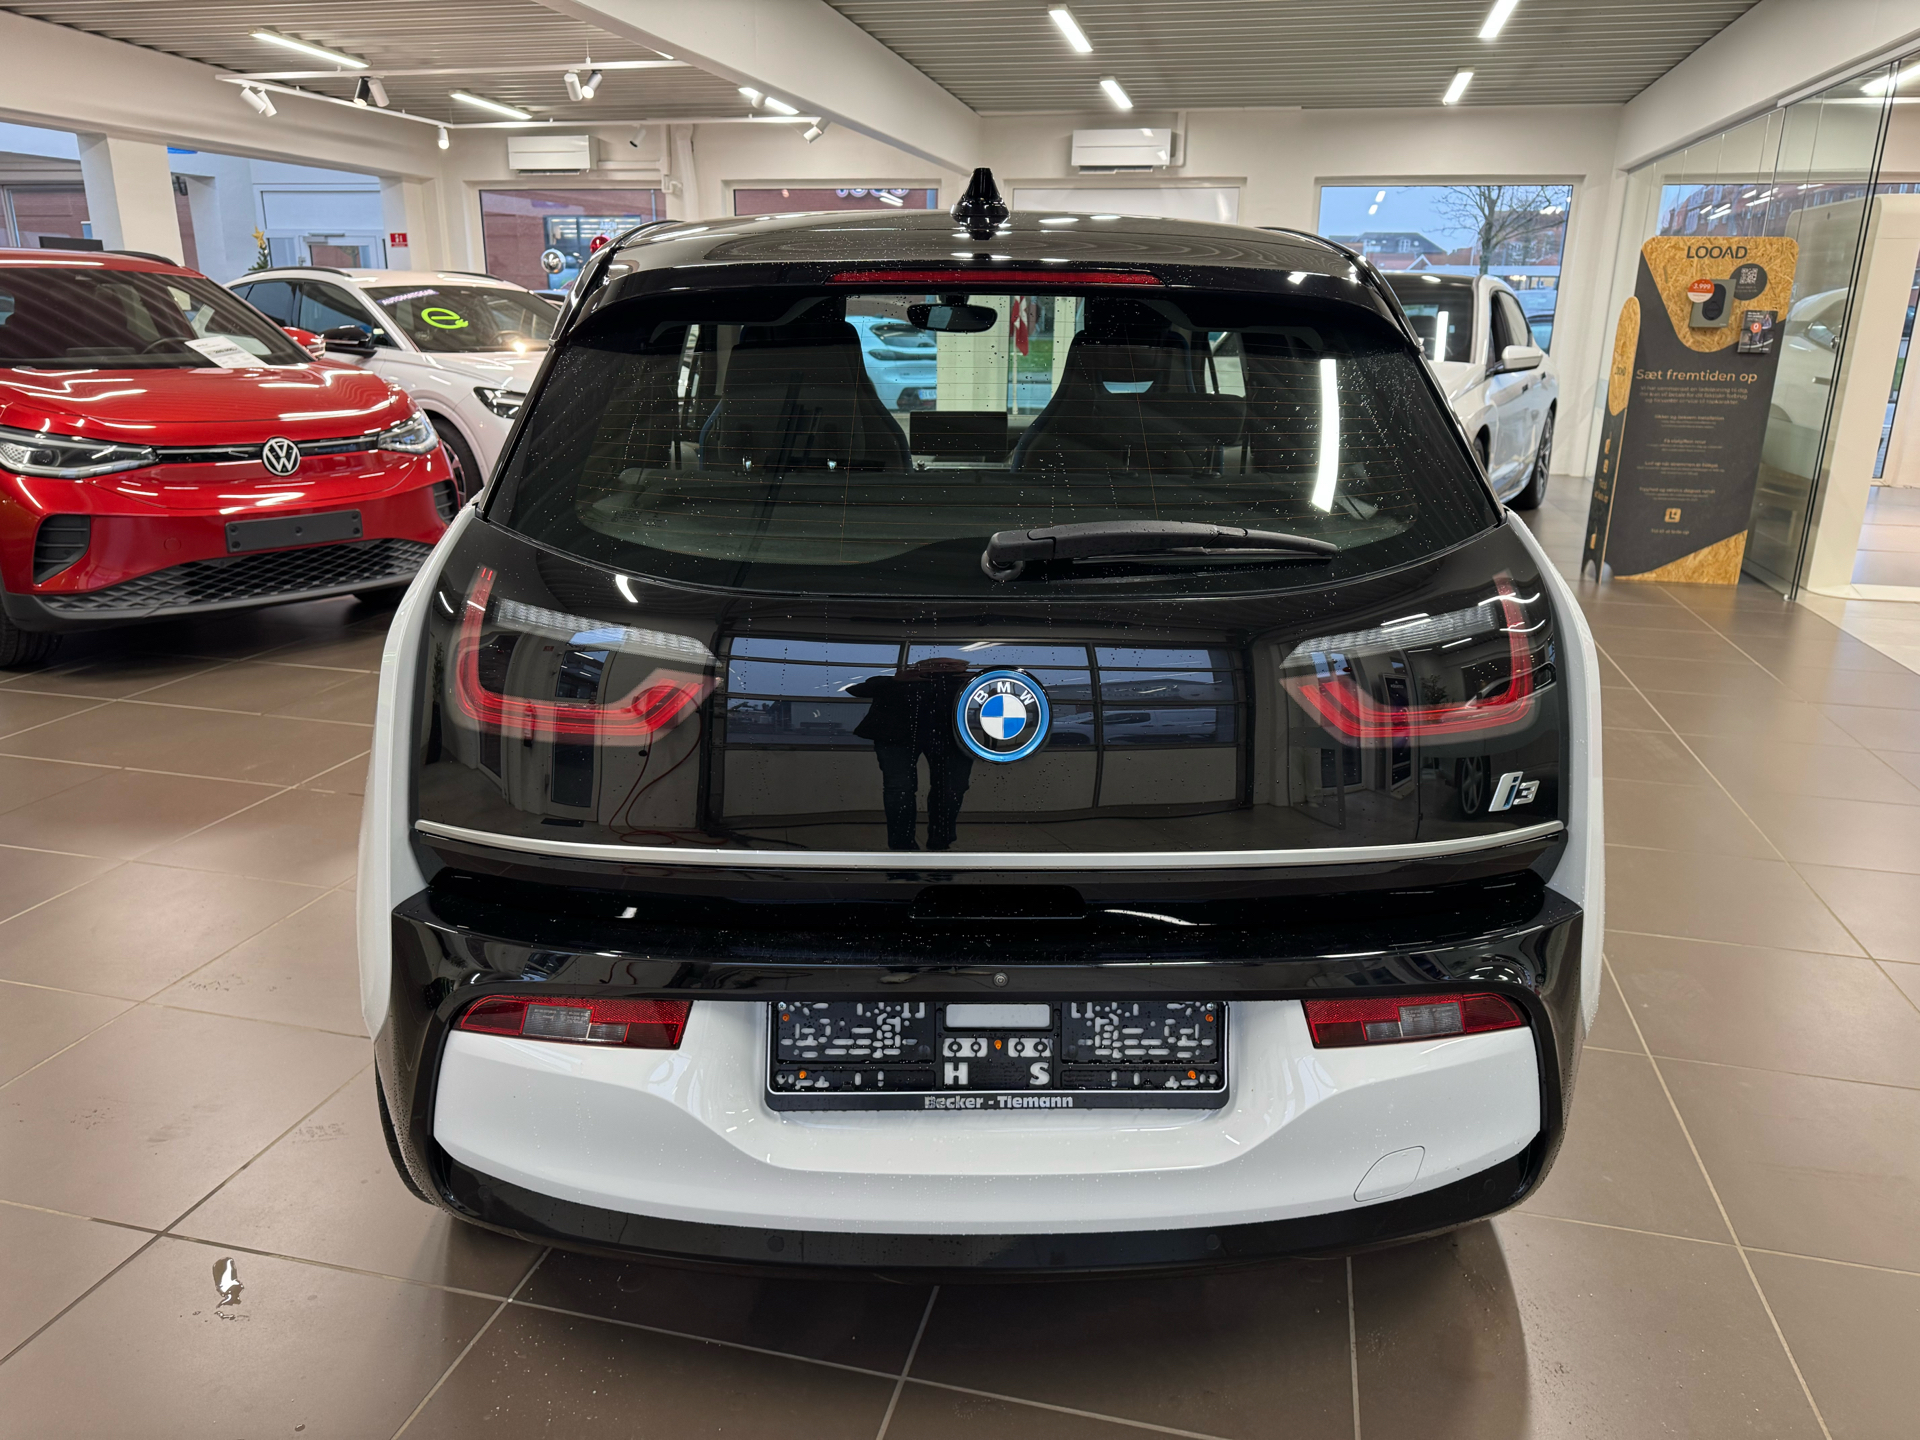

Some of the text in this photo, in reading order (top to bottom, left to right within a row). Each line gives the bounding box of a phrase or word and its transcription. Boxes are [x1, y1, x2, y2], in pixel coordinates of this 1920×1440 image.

[1686, 245, 1748, 259] LOOAD
[1692, 282, 1712, 290] 3.999
[1635, 368, 1663, 380] Sæt
[1666, 369, 1736, 382] fremtiden
[1739, 372, 1758, 384] op
[973, 681, 1035, 706] BMW
[1487, 770, 1541, 813] i3
[944, 1062, 969, 1085] H
[1029, 1062, 1051, 1086] S
[924, 1095, 984, 1109] Becker
[997, 1095, 1074, 1109] Tiemann
